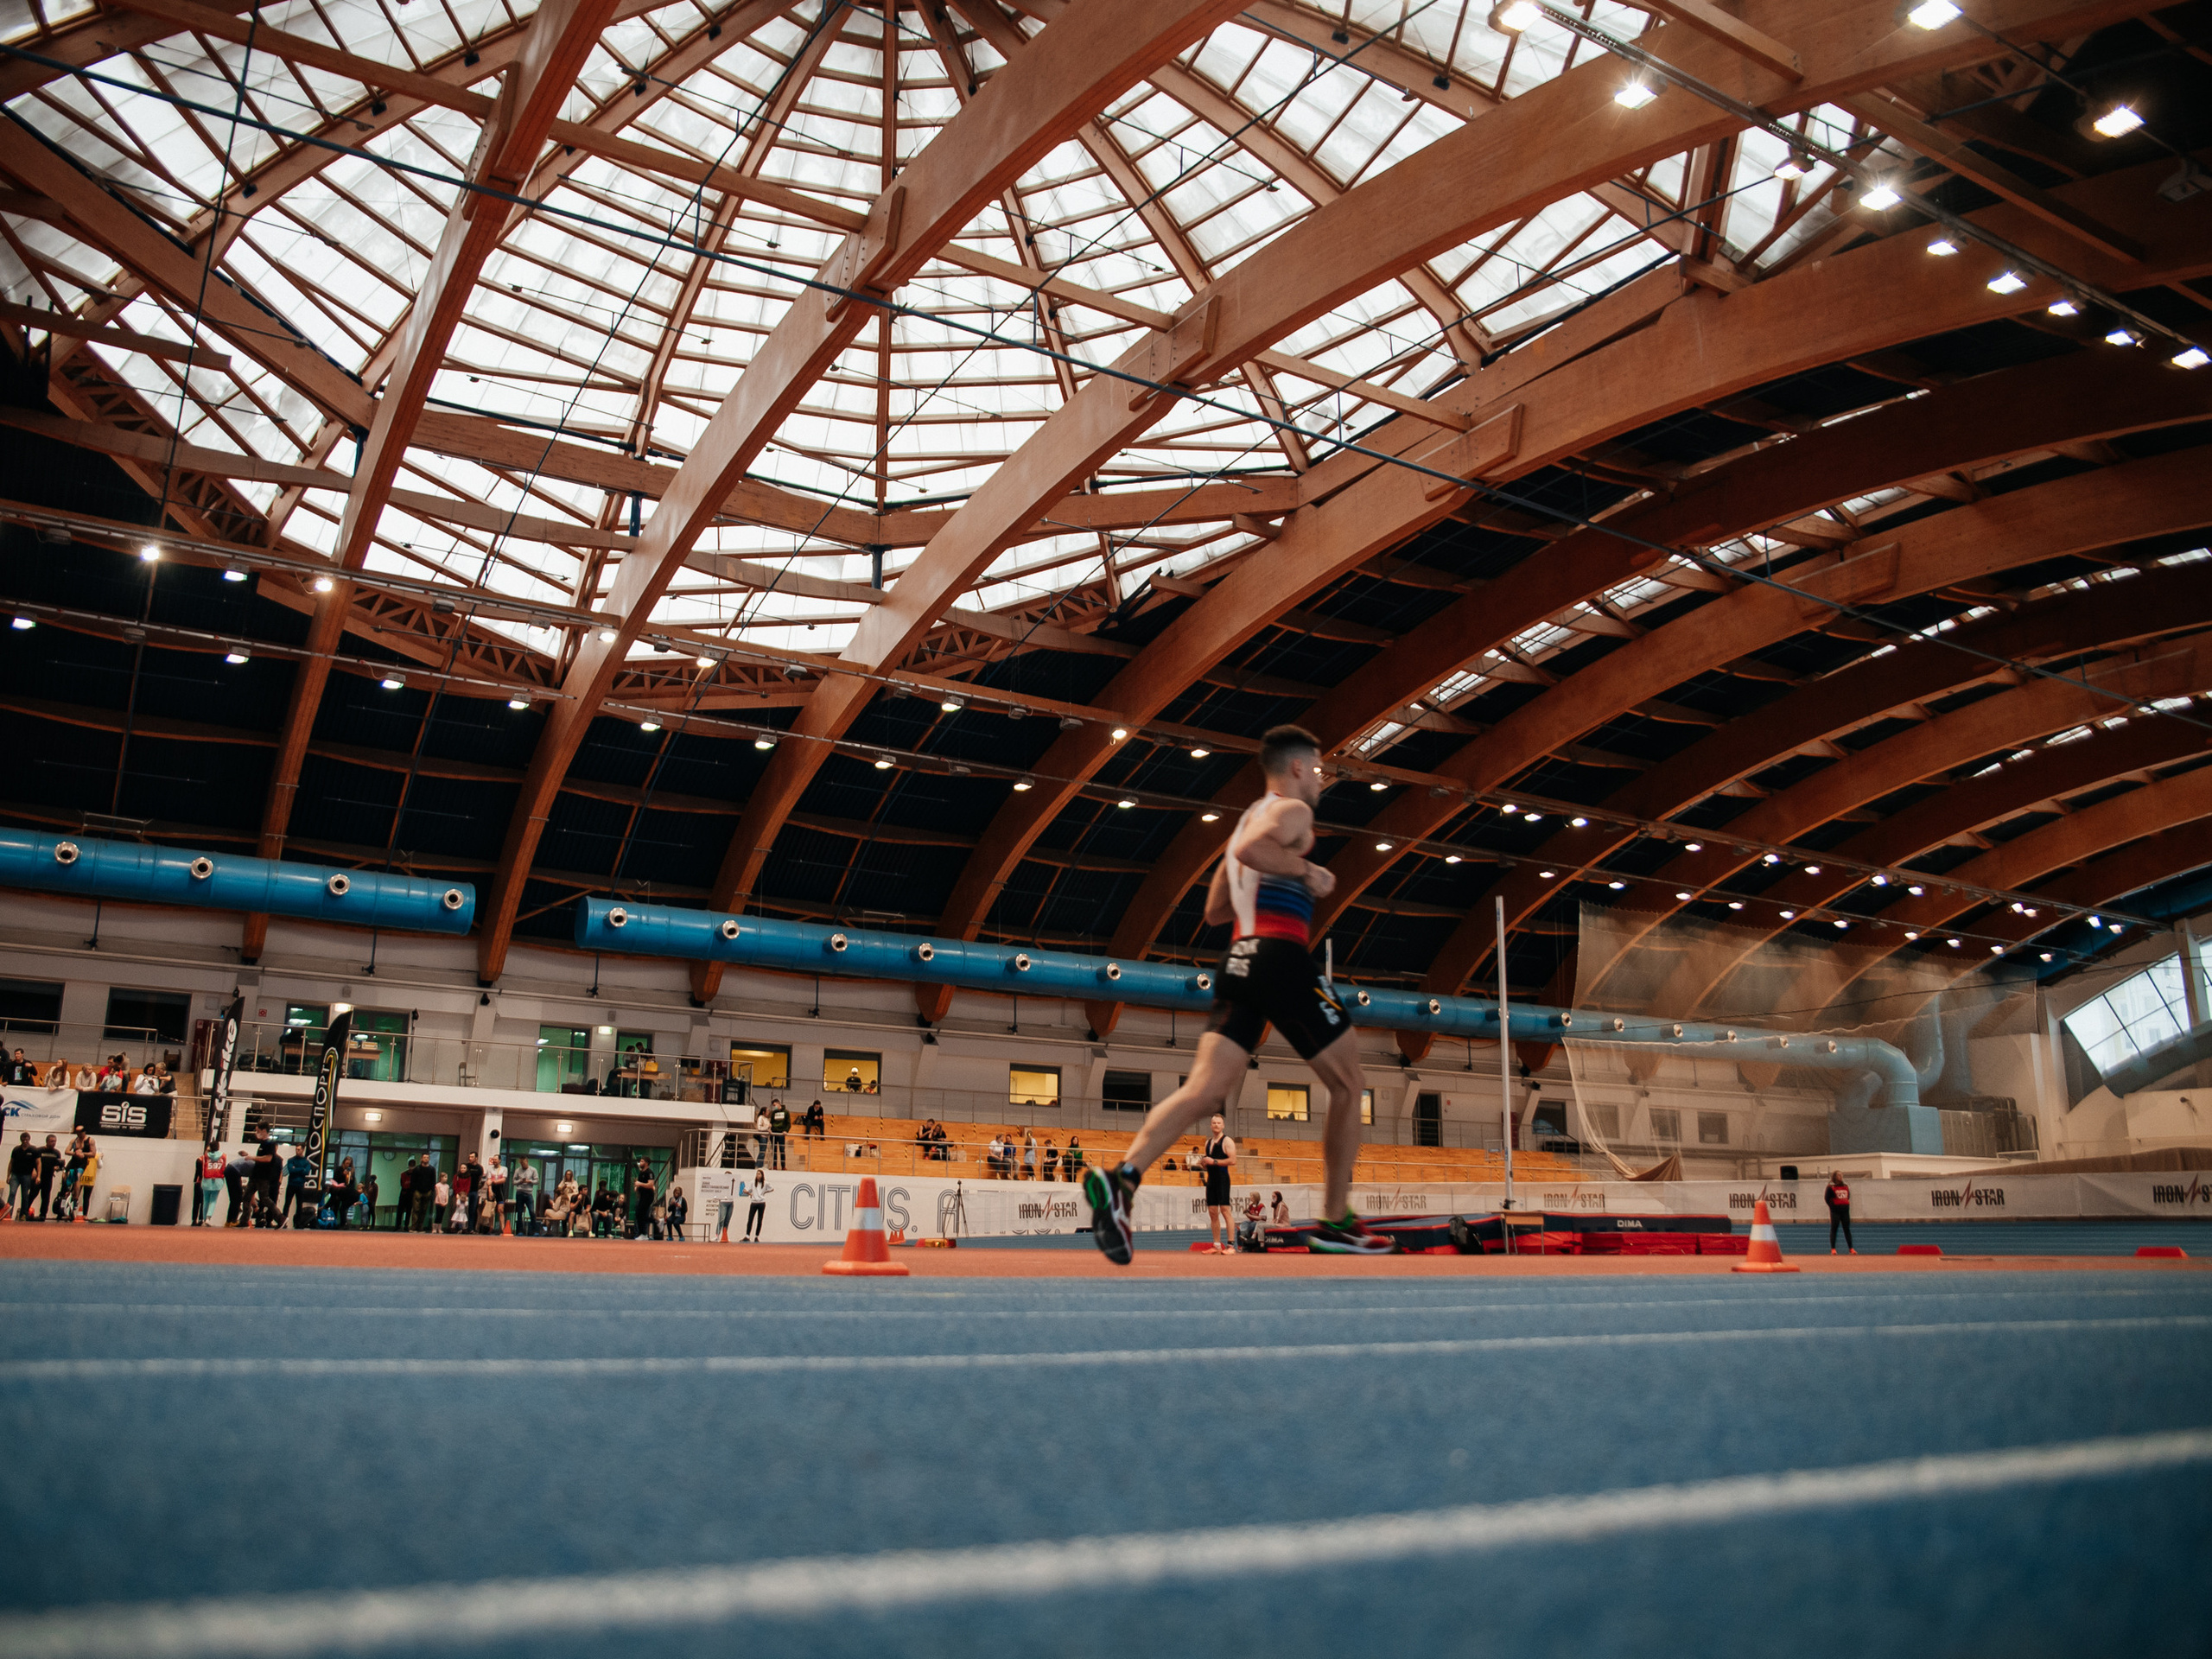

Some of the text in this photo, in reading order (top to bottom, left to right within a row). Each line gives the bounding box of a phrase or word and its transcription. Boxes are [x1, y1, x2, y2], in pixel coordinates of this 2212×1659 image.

[304, 1063, 331, 1189] ВЕЛОСПОРТ
[1729, 1192, 1797, 1209] IRON STAR
[1931, 1188, 2005, 1206] IRON STAR
[2152, 1185, 2184, 1204] IRON
[1617, 1219, 1643, 1228] DIMA
